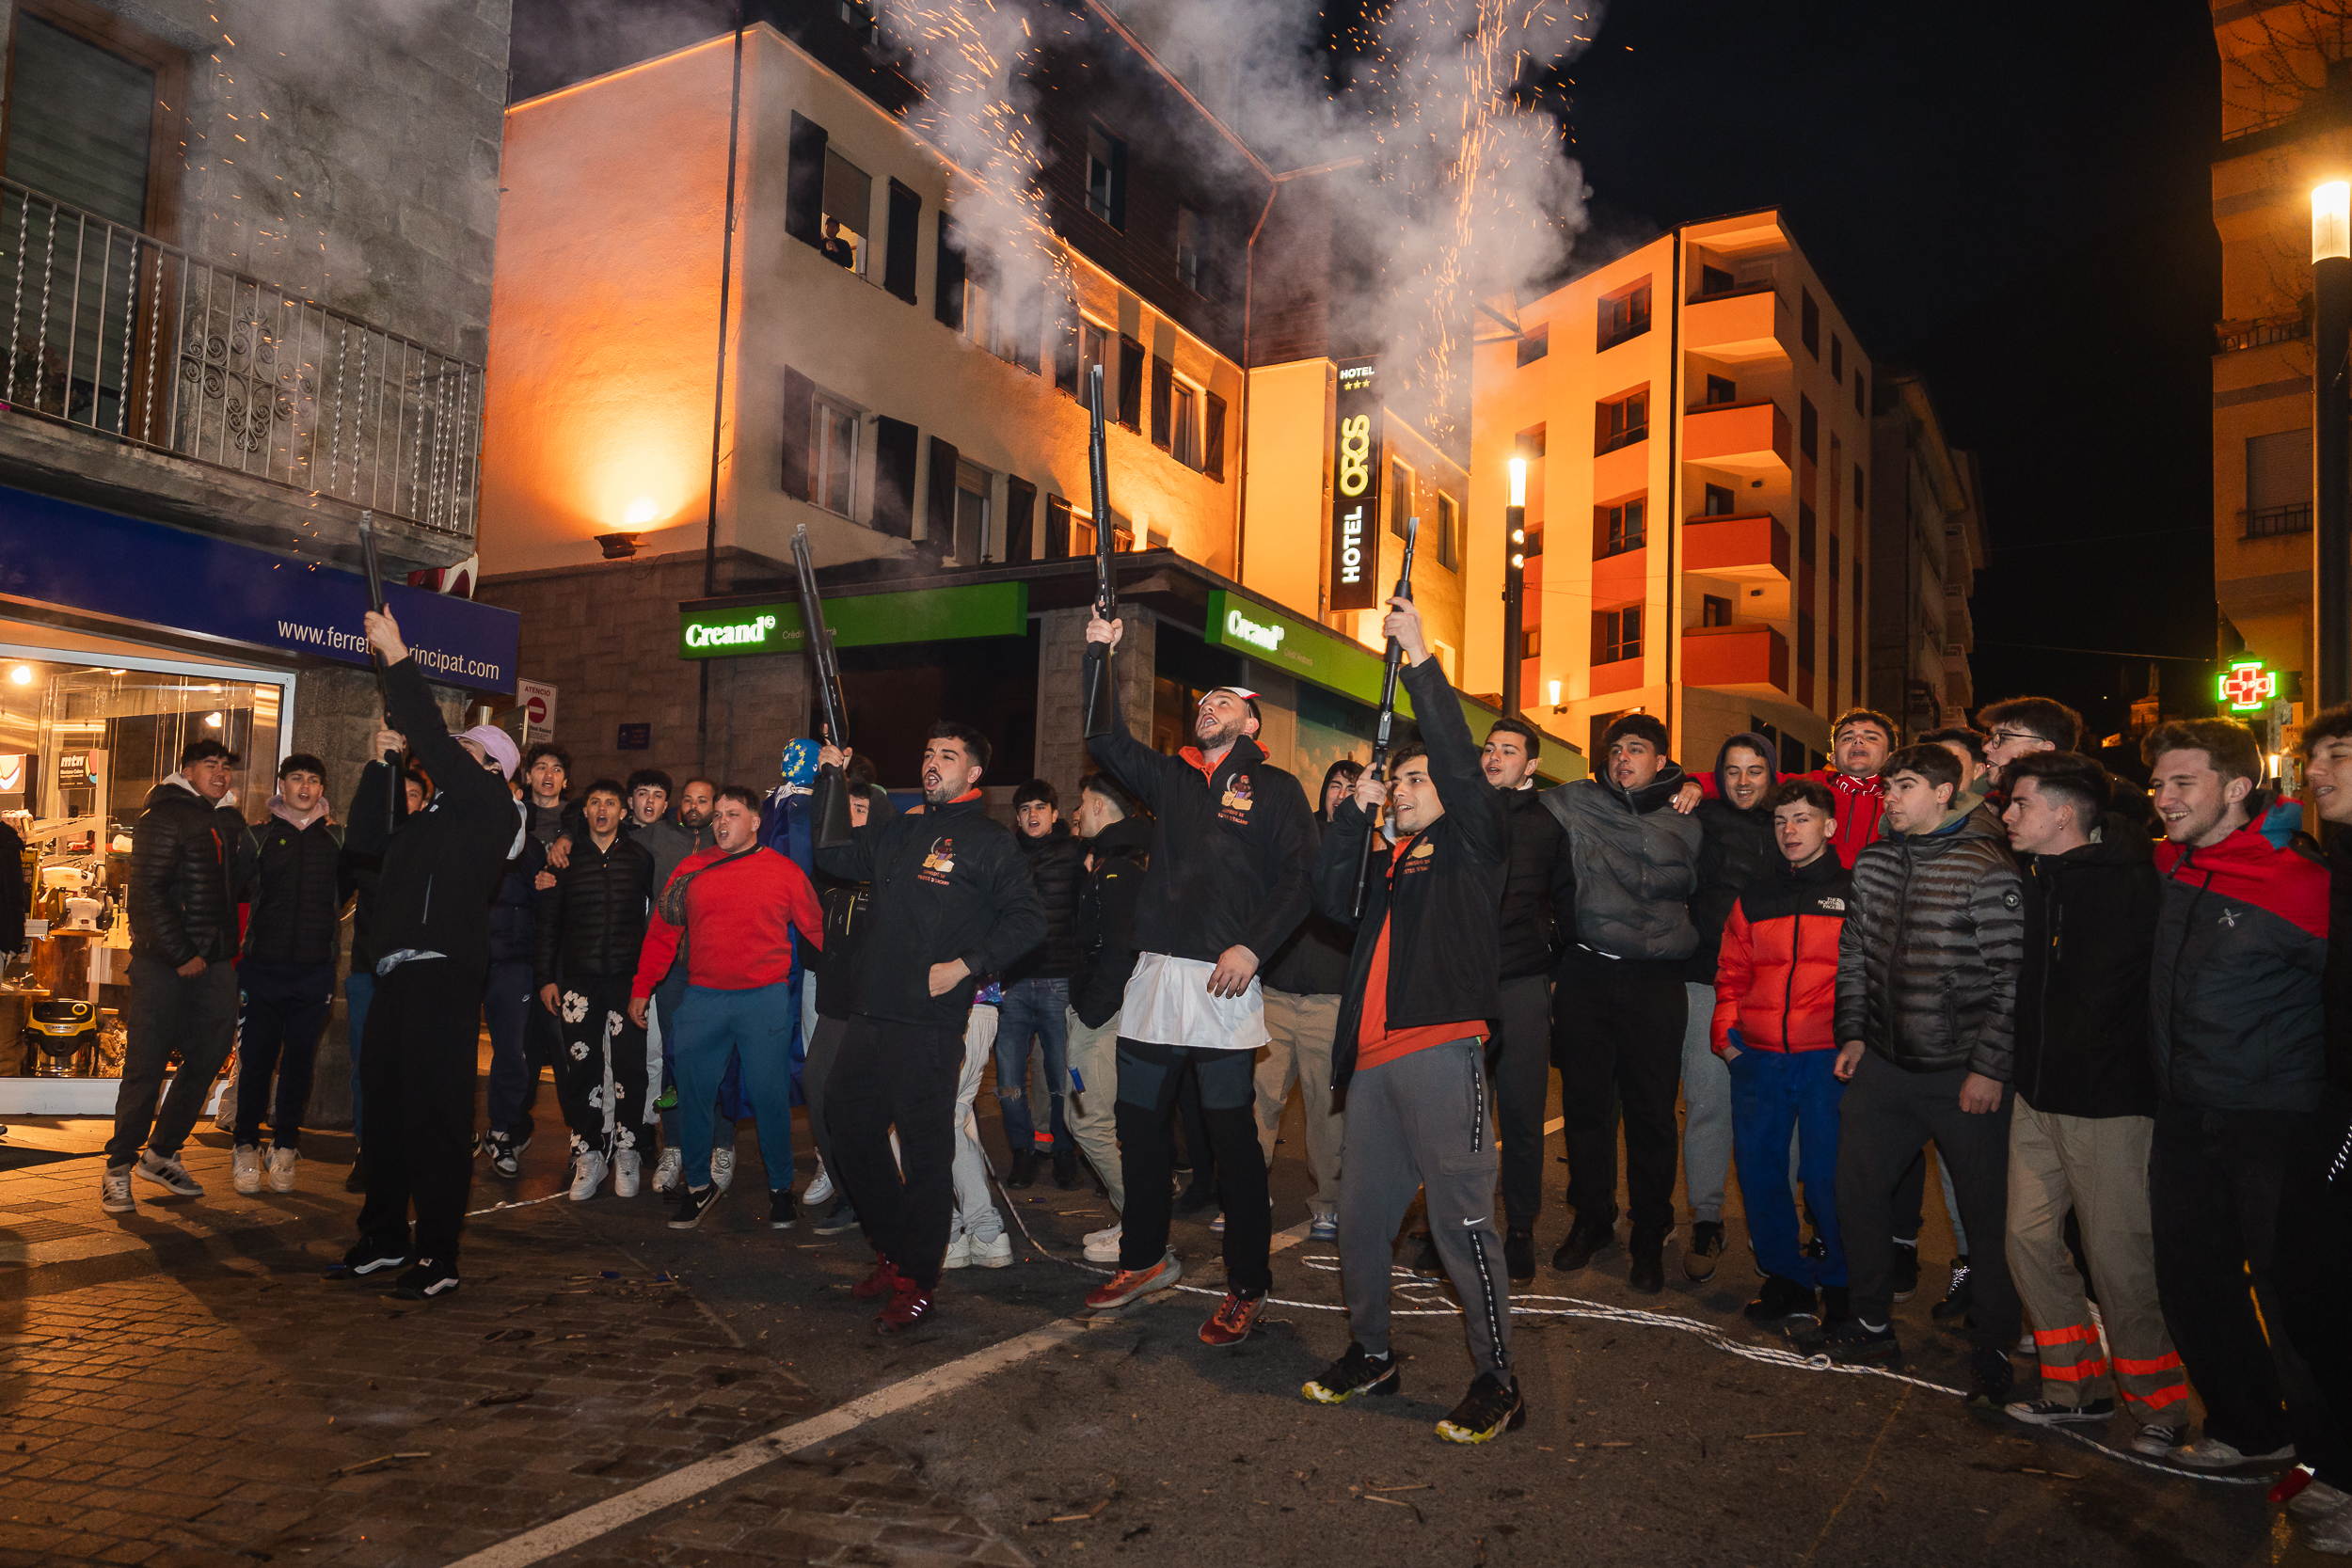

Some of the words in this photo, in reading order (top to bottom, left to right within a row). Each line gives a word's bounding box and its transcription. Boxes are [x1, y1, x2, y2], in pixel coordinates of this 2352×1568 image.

[1339, 366, 1375, 380] HOTEL
[1341, 505, 1363, 584] HOTEL
[278, 620, 501, 680] www.ferretrincipat.com
[524, 685, 551, 697] ATENCIÓ
[60, 755, 84, 767] mtn
